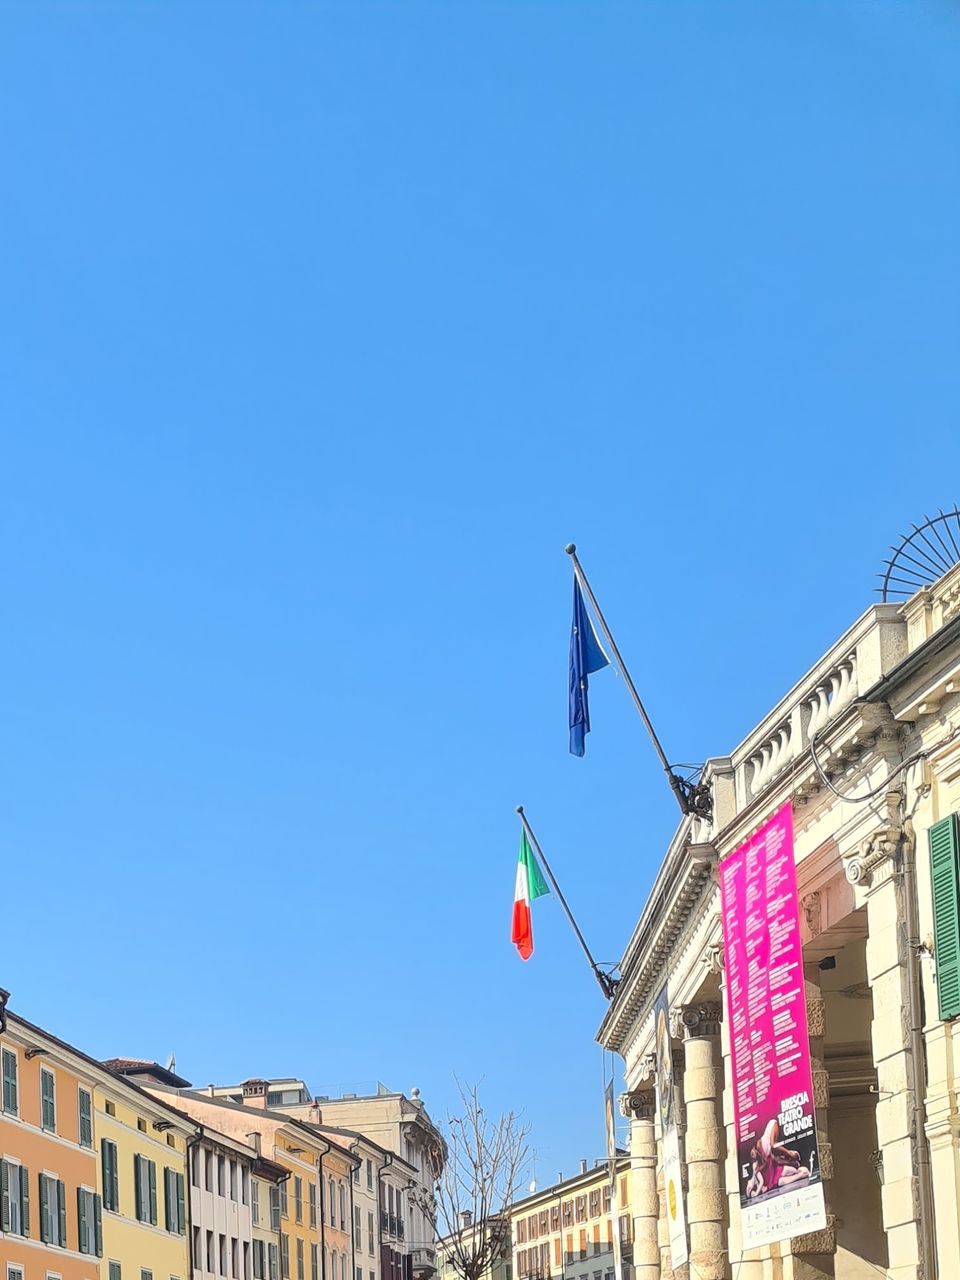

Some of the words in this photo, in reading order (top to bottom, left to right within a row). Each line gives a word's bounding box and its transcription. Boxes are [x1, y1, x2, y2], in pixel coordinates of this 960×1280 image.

[781, 1091, 809, 1112] BRESCIA
[777, 1106, 803, 1126] TEATRO
[783, 1115, 813, 1136] GRANDE
